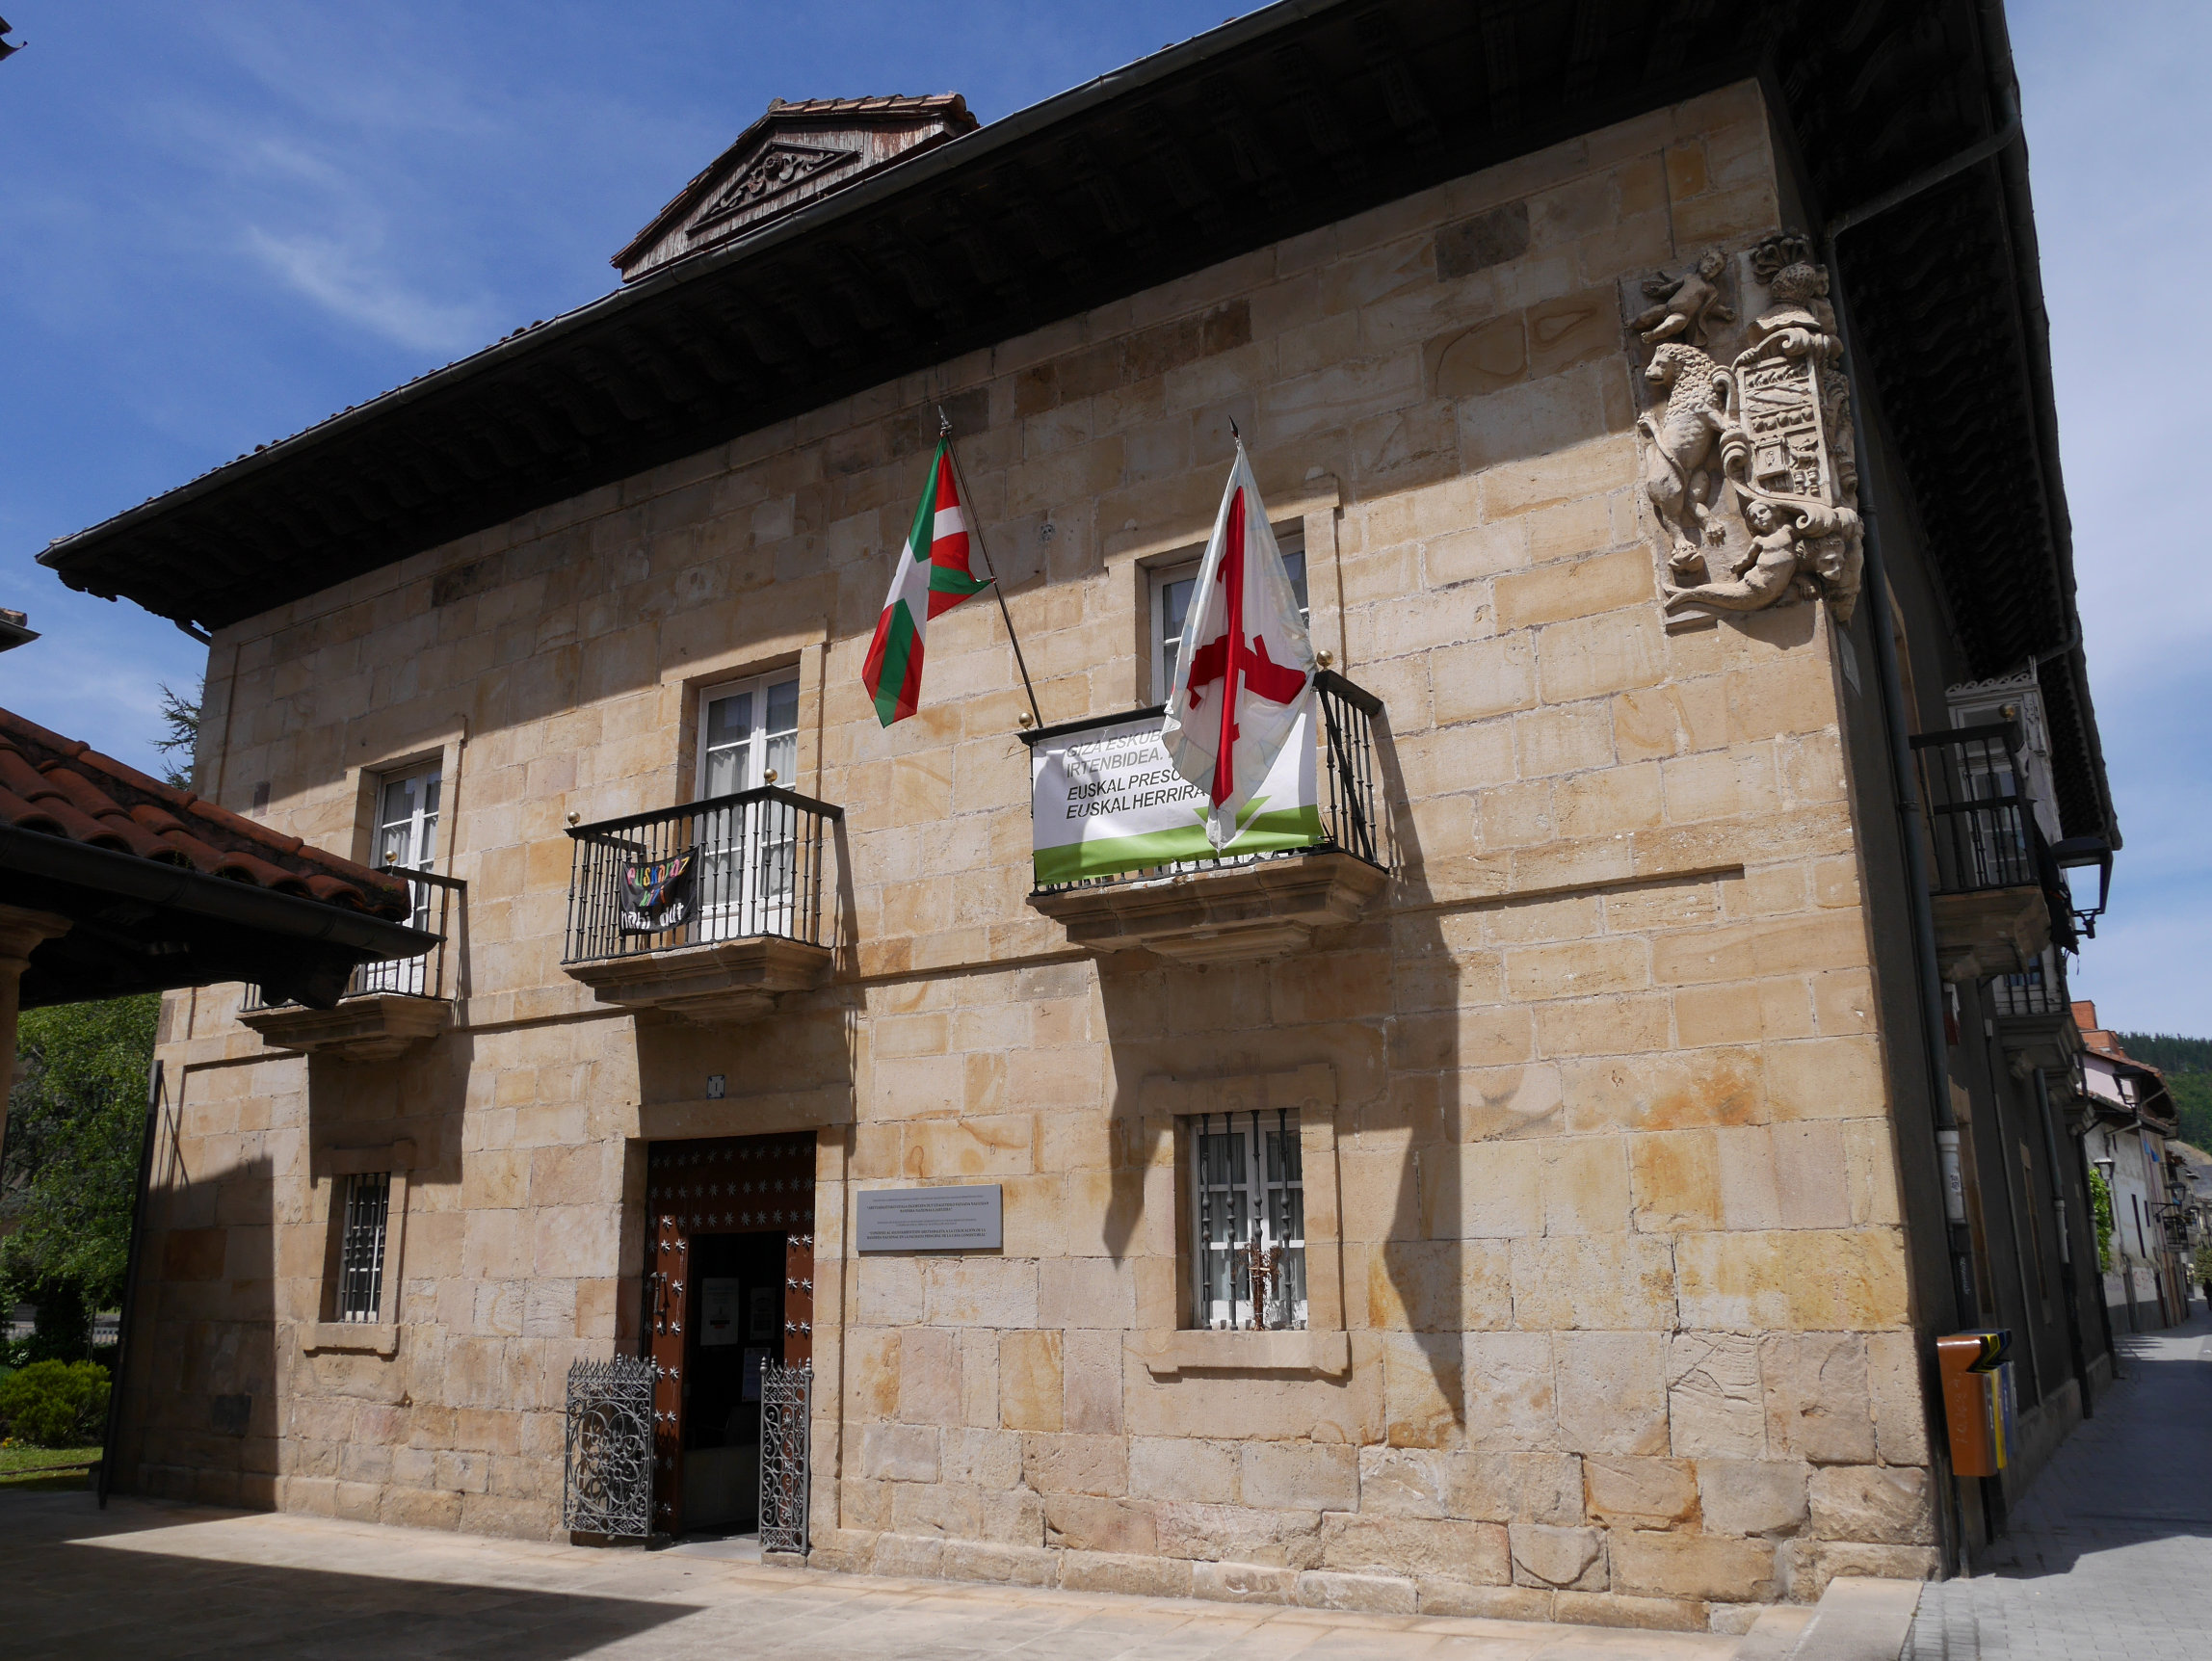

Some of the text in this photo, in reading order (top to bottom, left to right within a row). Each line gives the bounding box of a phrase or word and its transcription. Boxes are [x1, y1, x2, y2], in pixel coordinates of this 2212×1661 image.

[1066, 739, 1101, 758] GIZA
[1066, 747, 1164, 778] IRTENBIDEA.
[1066, 778, 1125, 801] EUSKAL
[1066, 784, 1206, 820] EUSKAL HERRIRA
[627, 856, 690, 886] euskaraz
[639, 884, 666, 907] bizi
[621, 902, 684, 930] nahi dut
